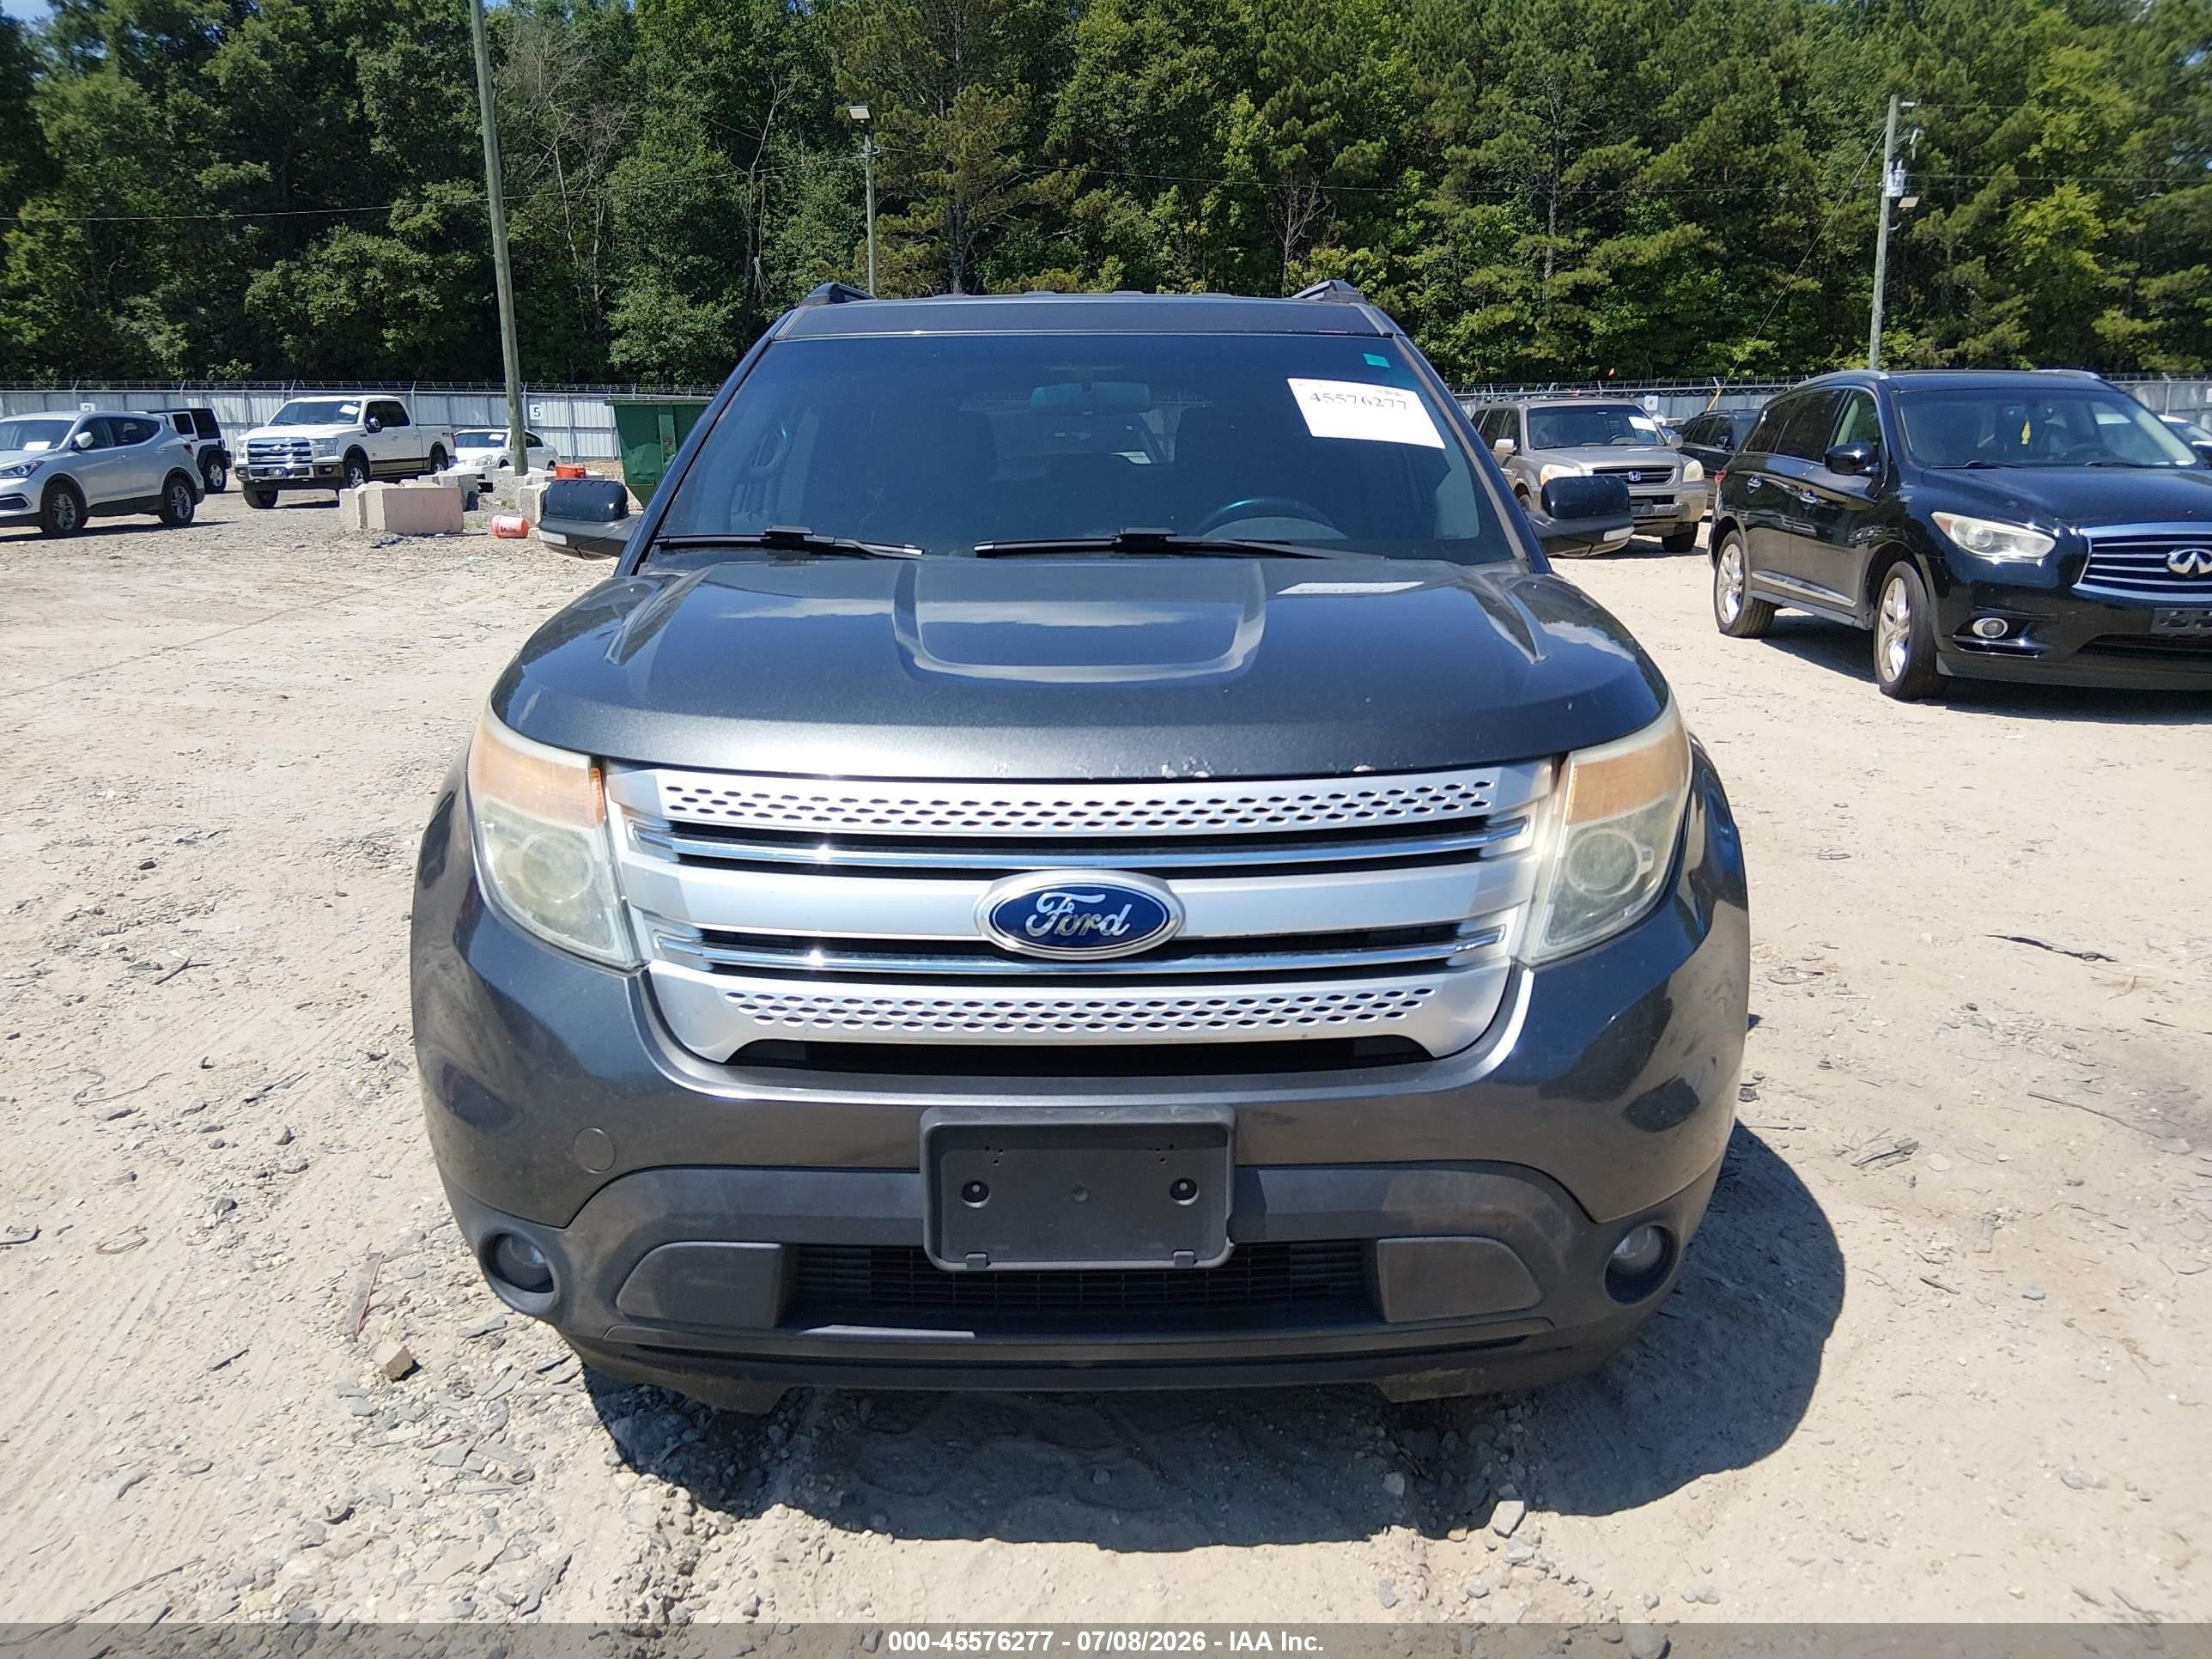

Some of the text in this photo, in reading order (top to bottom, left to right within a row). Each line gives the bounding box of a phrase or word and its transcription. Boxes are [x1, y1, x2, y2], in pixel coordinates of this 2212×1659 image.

[1310, 392, 1407, 410] 45576277
[533, 406, 541, 417] 5
[1025, 891, 1133, 937] Ford
